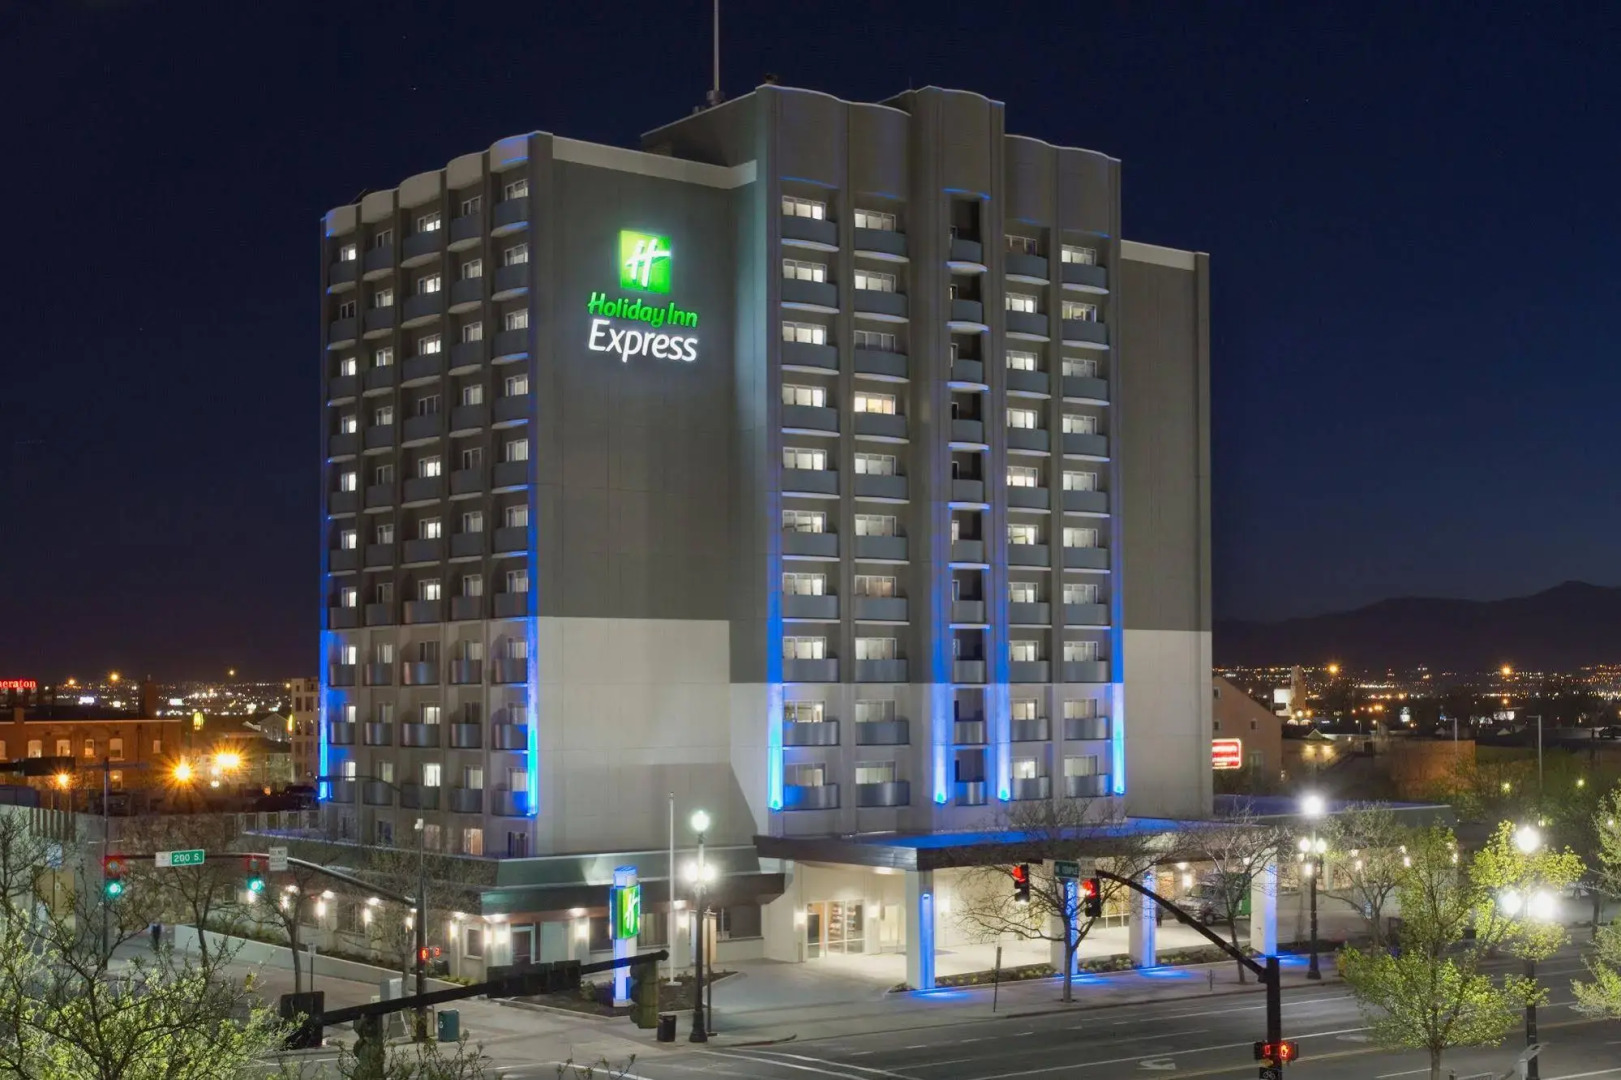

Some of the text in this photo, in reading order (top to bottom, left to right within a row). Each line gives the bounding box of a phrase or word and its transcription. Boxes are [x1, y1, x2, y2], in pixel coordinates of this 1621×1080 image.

[587, 291, 698, 328] Holiday Inn
[588, 318, 698, 363] Express
[0, 679, 36, 689] eraton
[174, 854, 190, 863] 200
